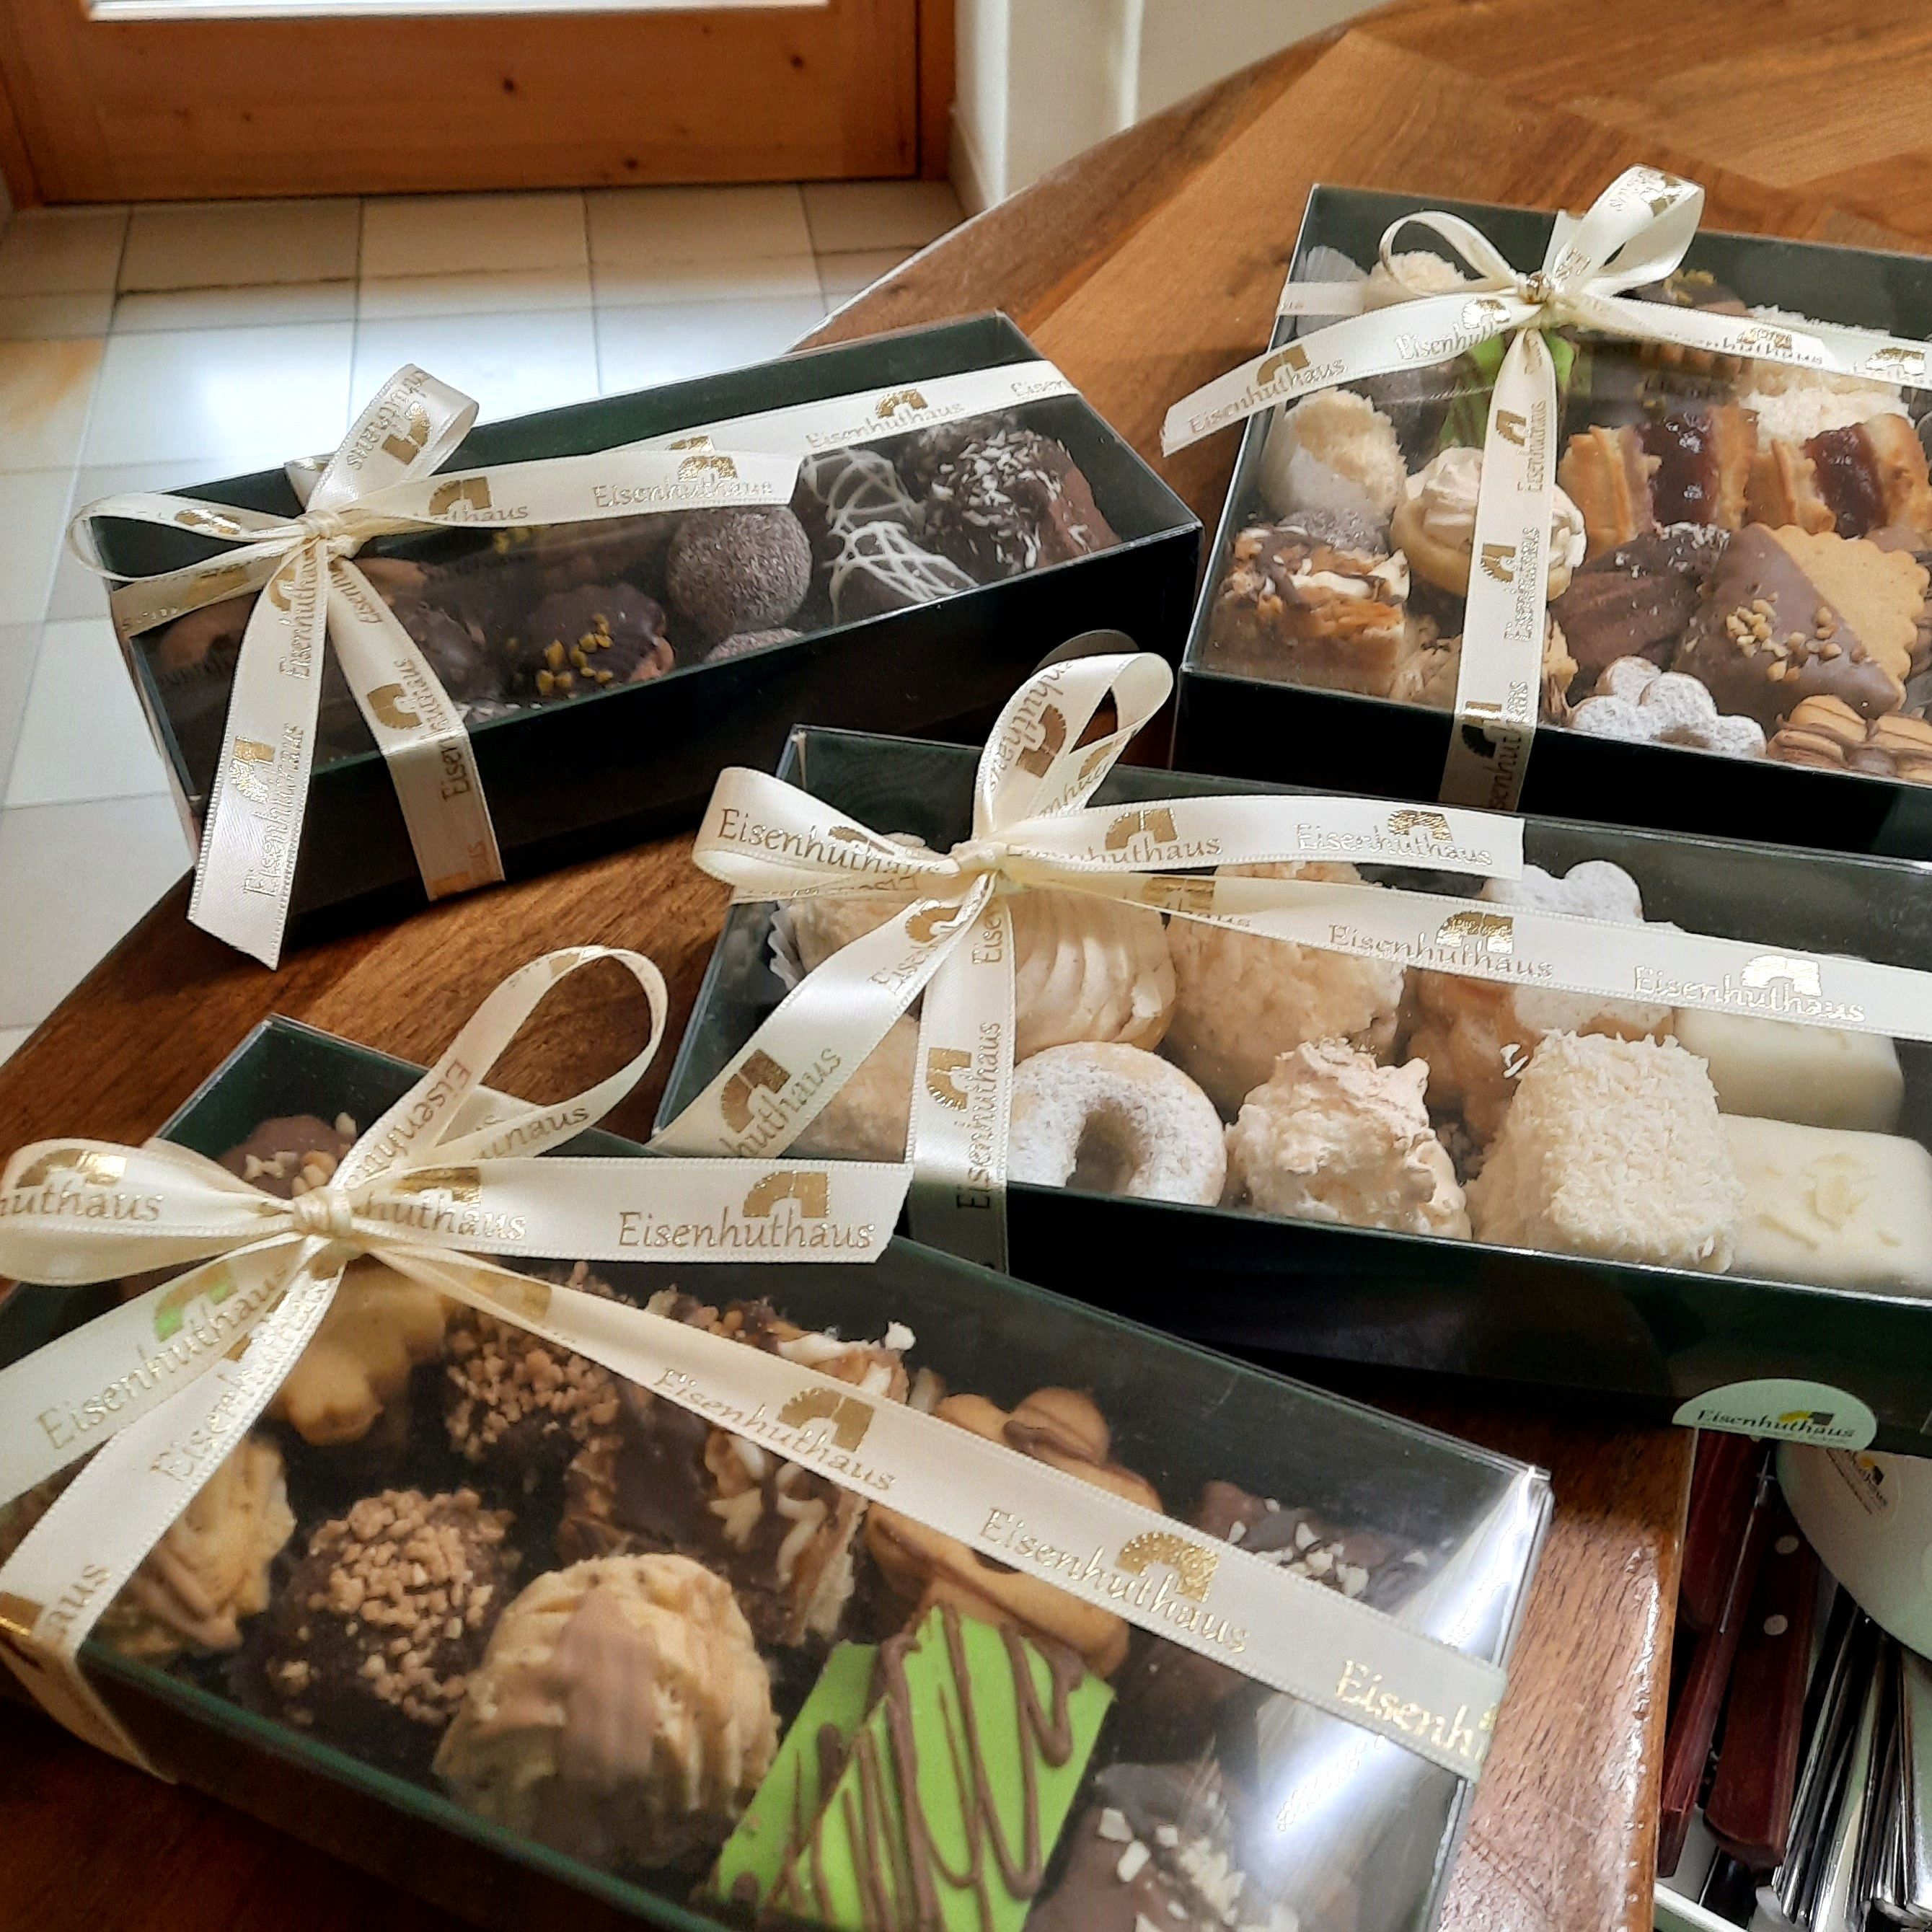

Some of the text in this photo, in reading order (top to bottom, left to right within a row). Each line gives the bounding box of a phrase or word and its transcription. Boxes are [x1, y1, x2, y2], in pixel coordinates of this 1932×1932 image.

[1188, 355, 1348, 433] Eisenhuthaus
[804, 401, 966, 448] Eisenhuthaus
[1293, 824, 1492, 866] Eisenhuthaus
[1329, 923, 1554, 982] Eisenhuthaus
[1634, 965, 1866, 1023] Eisenhuthaus
[957, 1021, 1004, 1210] Eisenhuthaus
[618, 1210, 876, 1249] Eisenhuthaus
[653, 1367, 897, 1492] Eisenhuthaus
[1695, 1408, 1856, 1438] Eisenhuthaus
[979, 1507, 1252, 1655] Eisenhuthaus
